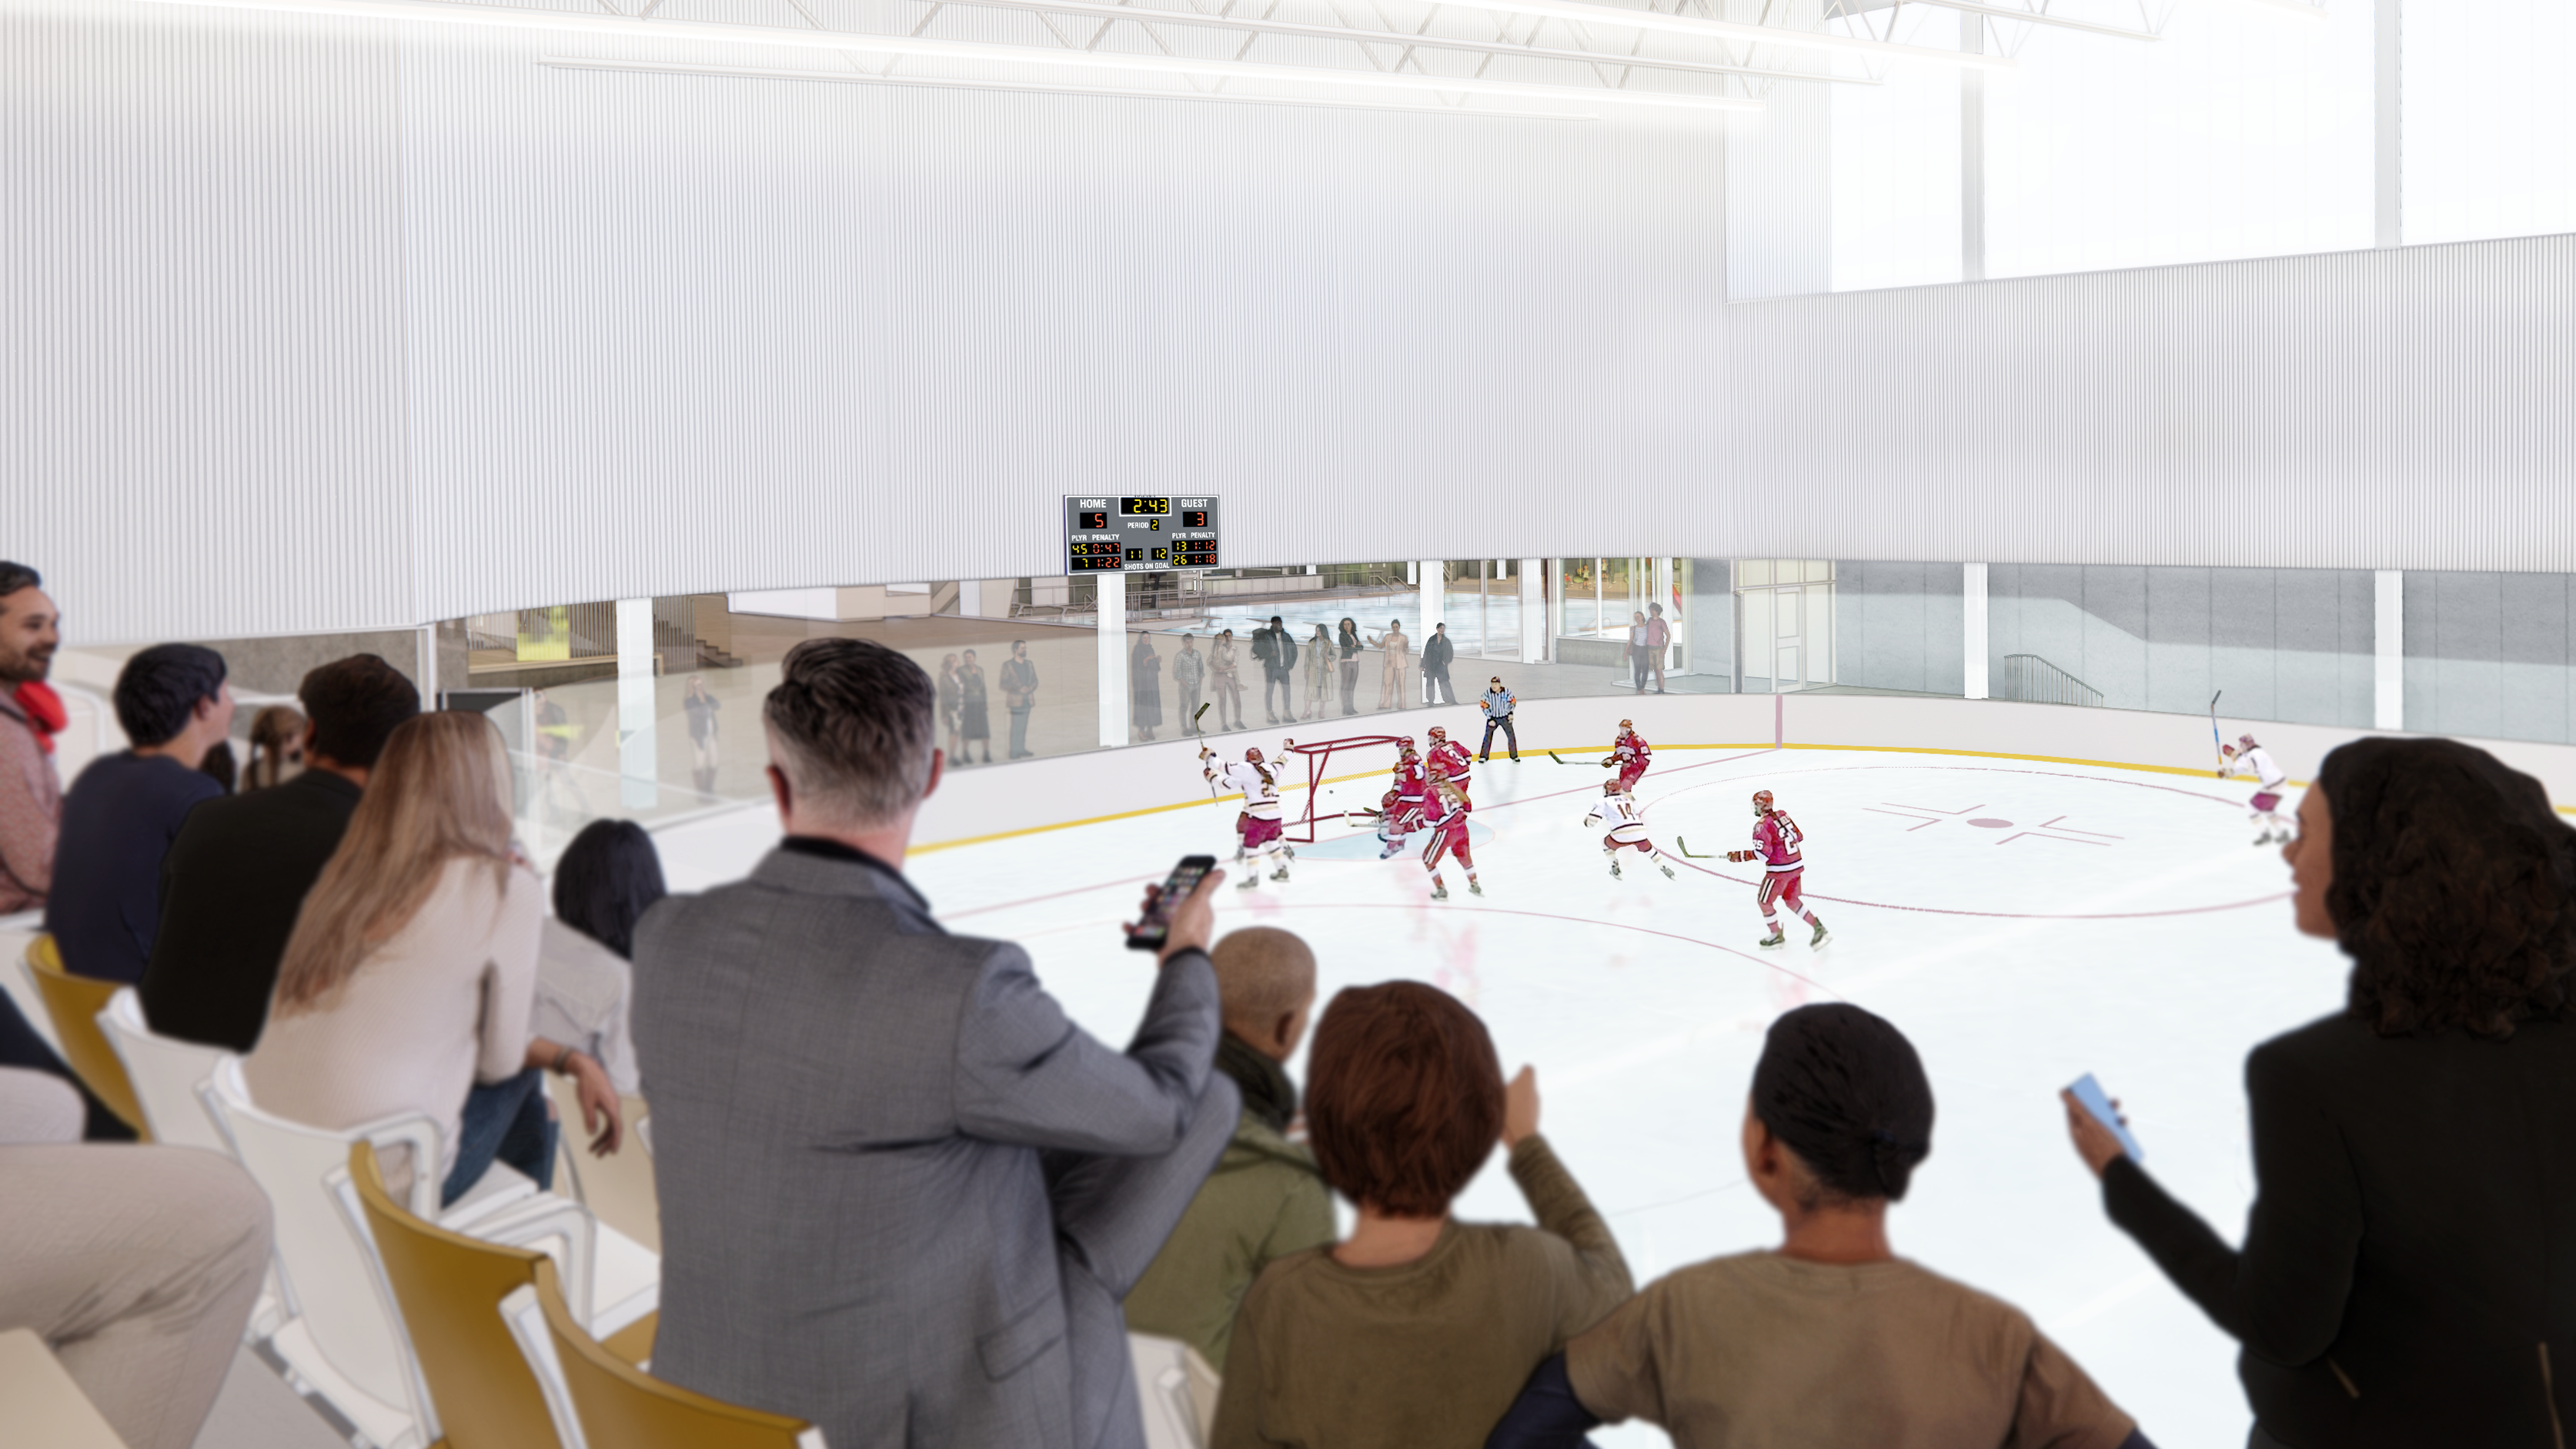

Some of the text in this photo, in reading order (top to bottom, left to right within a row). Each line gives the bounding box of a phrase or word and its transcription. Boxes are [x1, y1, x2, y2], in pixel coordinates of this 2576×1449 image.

[1080, 499, 1106, 508] HOME
[1133, 499, 1168, 513] 2:43
[1181, 499, 1208, 507] GUEST
[1094, 513, 1104, 528] 5
[1151, 520, 1158, 529] 2
[1197, 512, 1204, 526] 3
[1072, 543, 1120, 554] 45 0:47
[1176, 540, 1215, 551] 13 1:12
[1131, 550, 1141, 559] 11
[1156, 549, 1165, 559] 12
[1173, 553, 1215, 565] 26 1:18
[1082, 557, 1120, 568] 7 1:22
